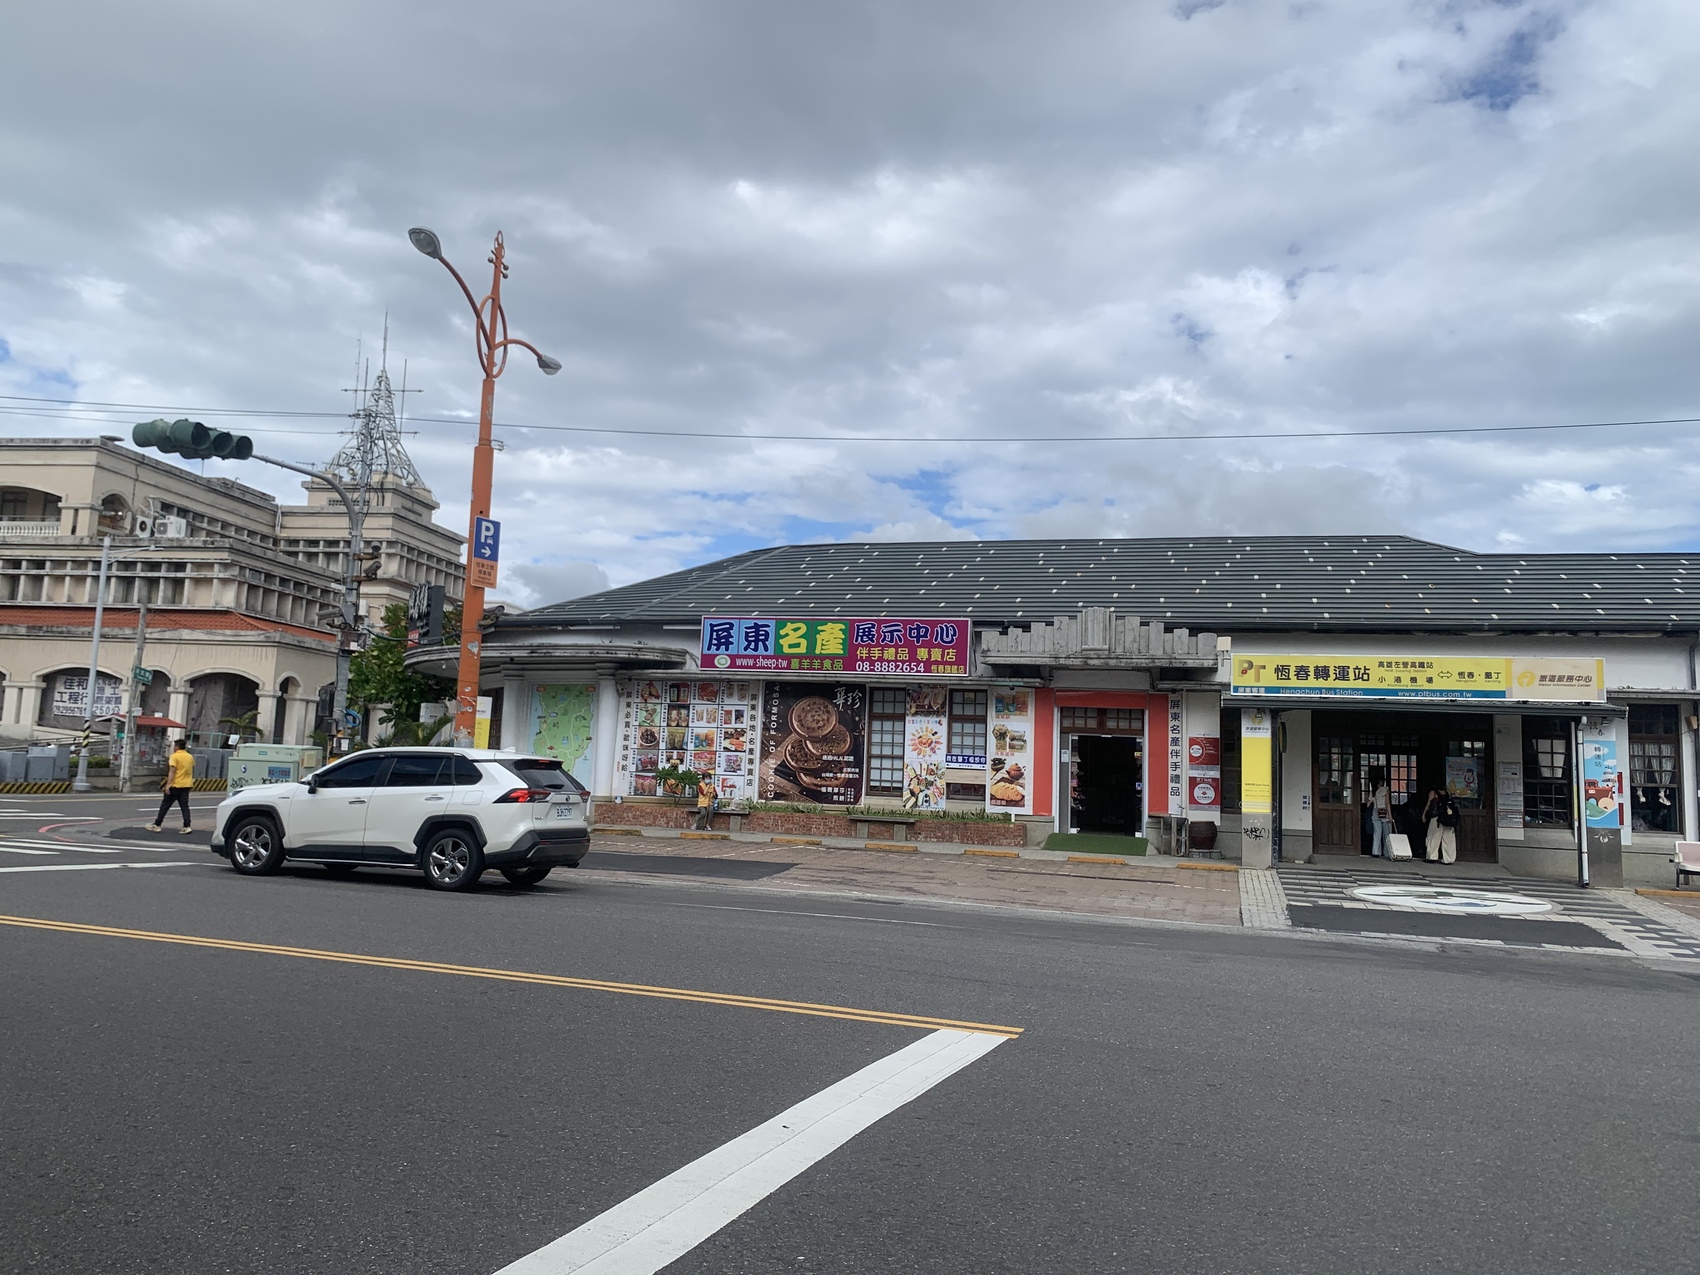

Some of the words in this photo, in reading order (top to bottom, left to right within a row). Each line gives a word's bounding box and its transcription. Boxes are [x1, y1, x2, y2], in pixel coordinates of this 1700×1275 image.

[480, 521, 495, 543] P
[706, 622, 847, 655] 屏東名產
[853, 622, 958, 645] 展示中心
[856, 647, 909, 660] 伴手禮品
[916, 648, 957, 661] 專賣店
[790, 658, 843, 671] 喜羊羊食品
[856, 661, 925, 673] 08-8882654
[931, 664, 965, 674] 恆春旗艦店
[1238, 659, 1266, 683] PT
[1377, 661, 1433, 669] 高雄左營高鐵站
[1273, 664, 1371, 682] 恆春轉運站
[1378, 675, 1434, 684] 小港機場
[1539, 674, 1592, 683] 旅遊服務中心
[64, 677, 88, 690] 佳和
[1280, 688, 1319, 696] Hengchun
[1322, 688, 1334, 696] Bus
[1336, 688, 1363, 696] Station
[1398, 690, 1472, 698] www.ptbus.com.tw
[770, 685, 780, 735] FORMOSA
[769, 740, 776, 753] OF
[1169, 700, 1181, 797] 屏東名產伴手禮品
